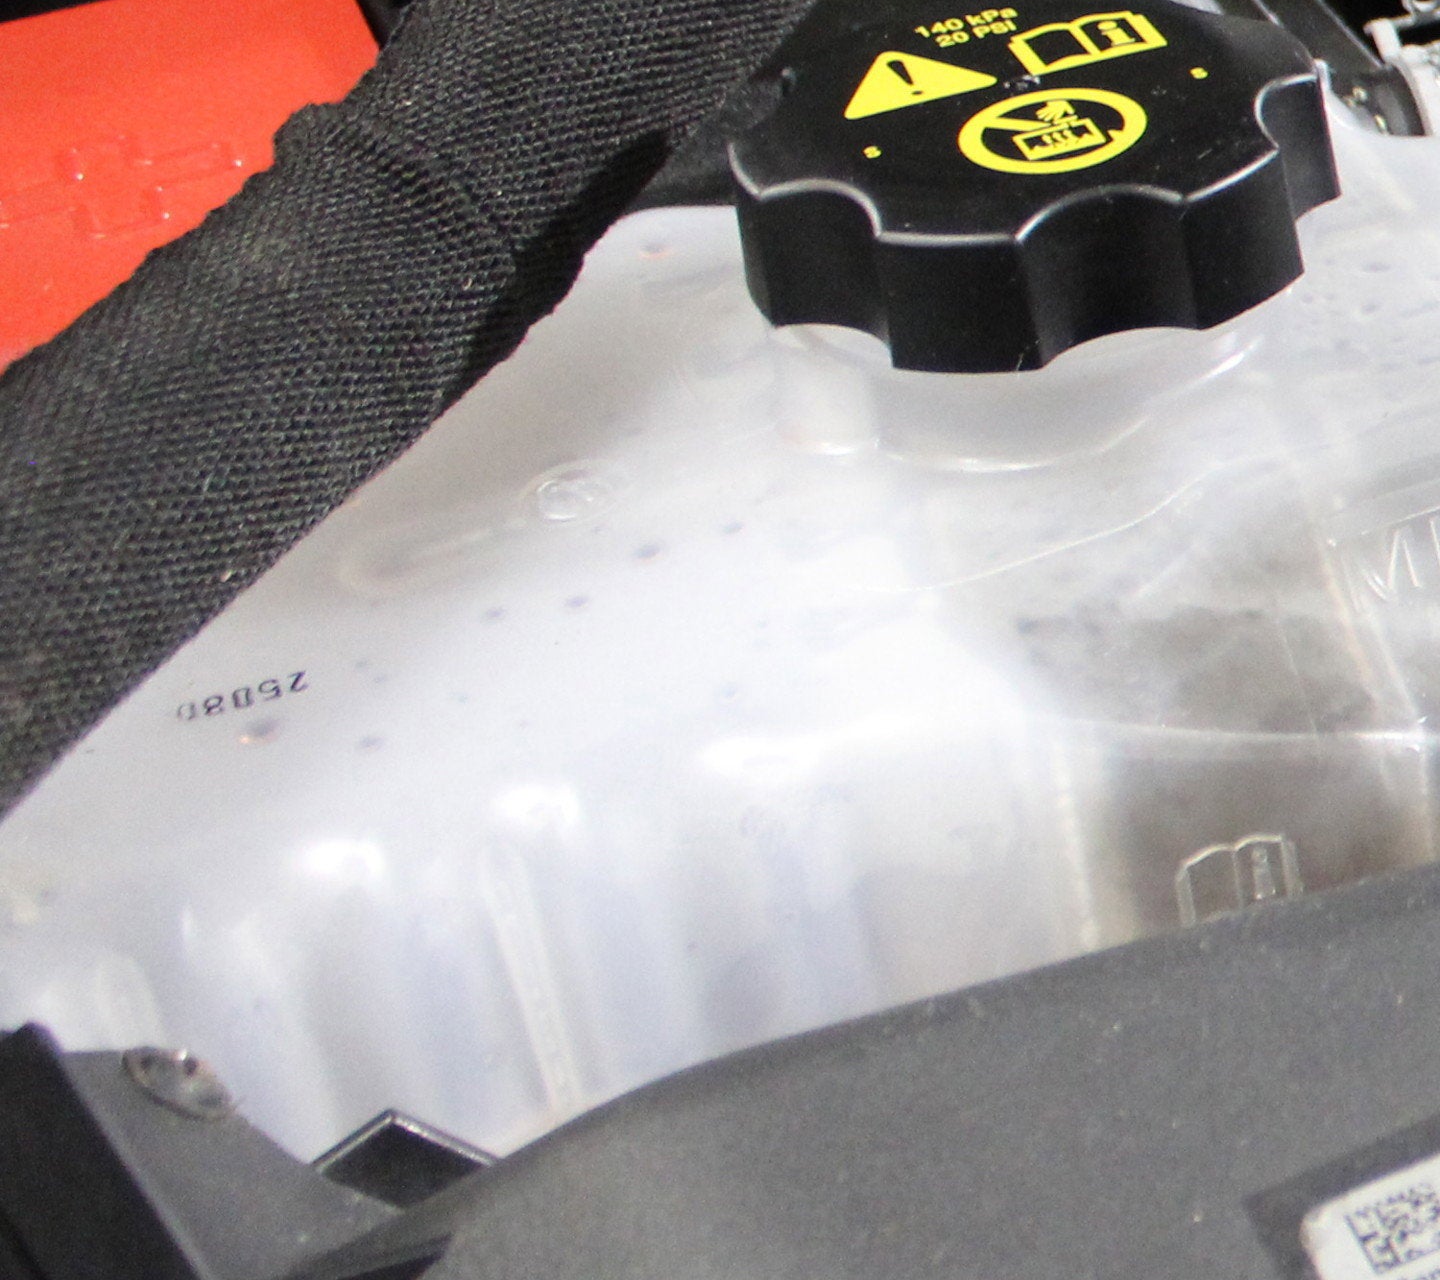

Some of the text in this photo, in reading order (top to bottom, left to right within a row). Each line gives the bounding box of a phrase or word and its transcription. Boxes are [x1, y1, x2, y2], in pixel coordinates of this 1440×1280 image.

[914, 6, 1018, 39] 140 kPa
[935, 20, 1017, 48] 20 PSI
